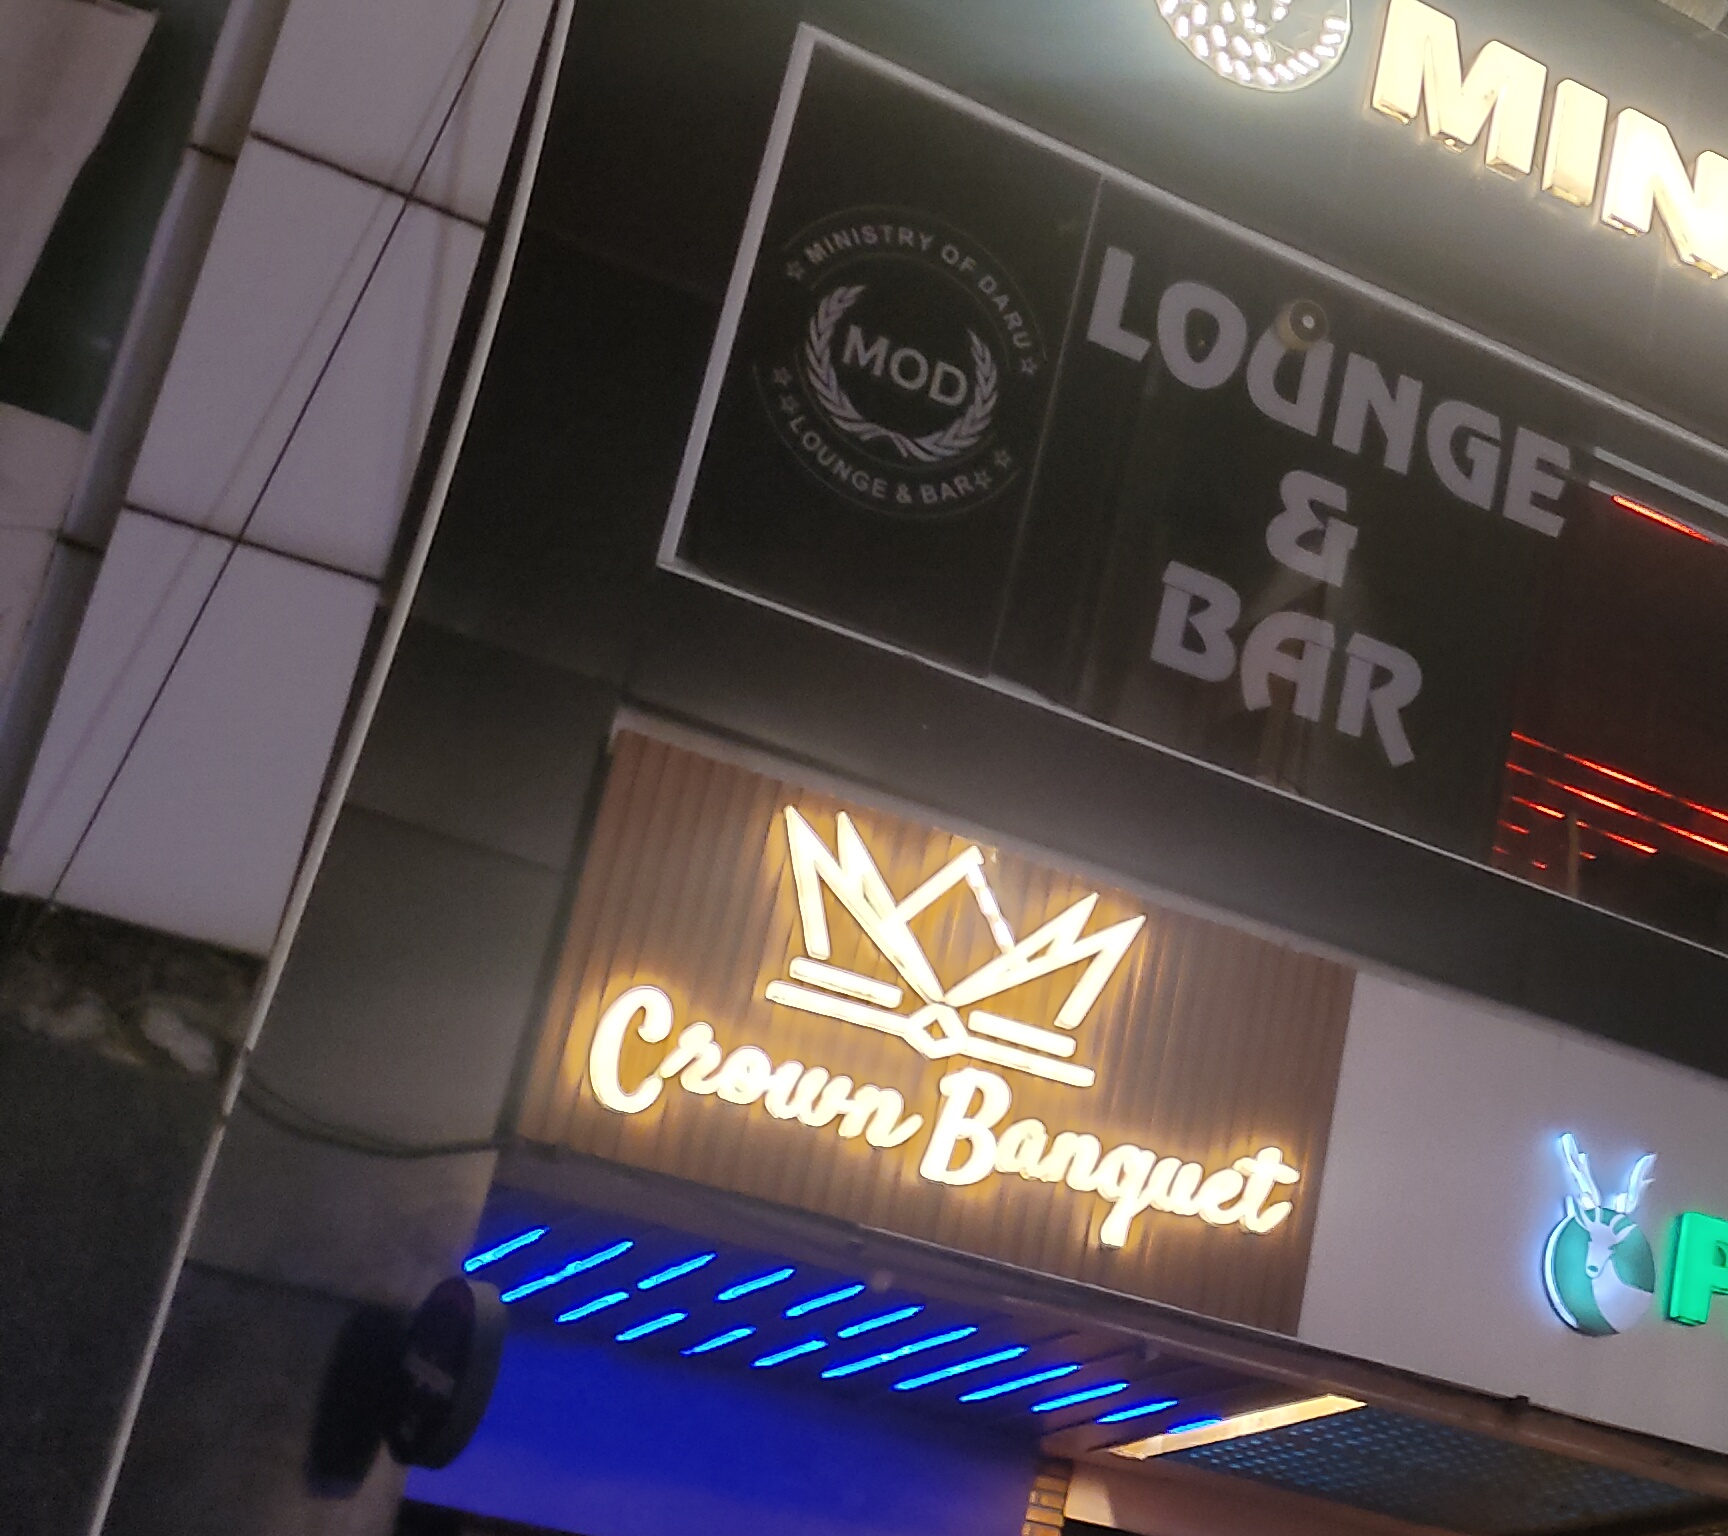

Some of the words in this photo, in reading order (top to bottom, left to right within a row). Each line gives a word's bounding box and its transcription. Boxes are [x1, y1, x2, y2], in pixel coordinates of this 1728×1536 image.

[804, 224, 935, 265] MINISTRY
[940, 243, 978, 272] OF
[977, 274, 1033, 350] DARU
[842, 324, 968, 407] MOD
[1085, 244, 1572, 538] LOUNGE
[789, 415, 889, 499] LOUNGE
[895, 480, 913, 504] &
[920, 474, 976, 505] BAR
[1265, 470, 1359, 588] &
[1149, 560, 1423, 768] BAR
[588, 983, 923, 1149] Crown
[919, 1067, 1300, 1249] Banquet
